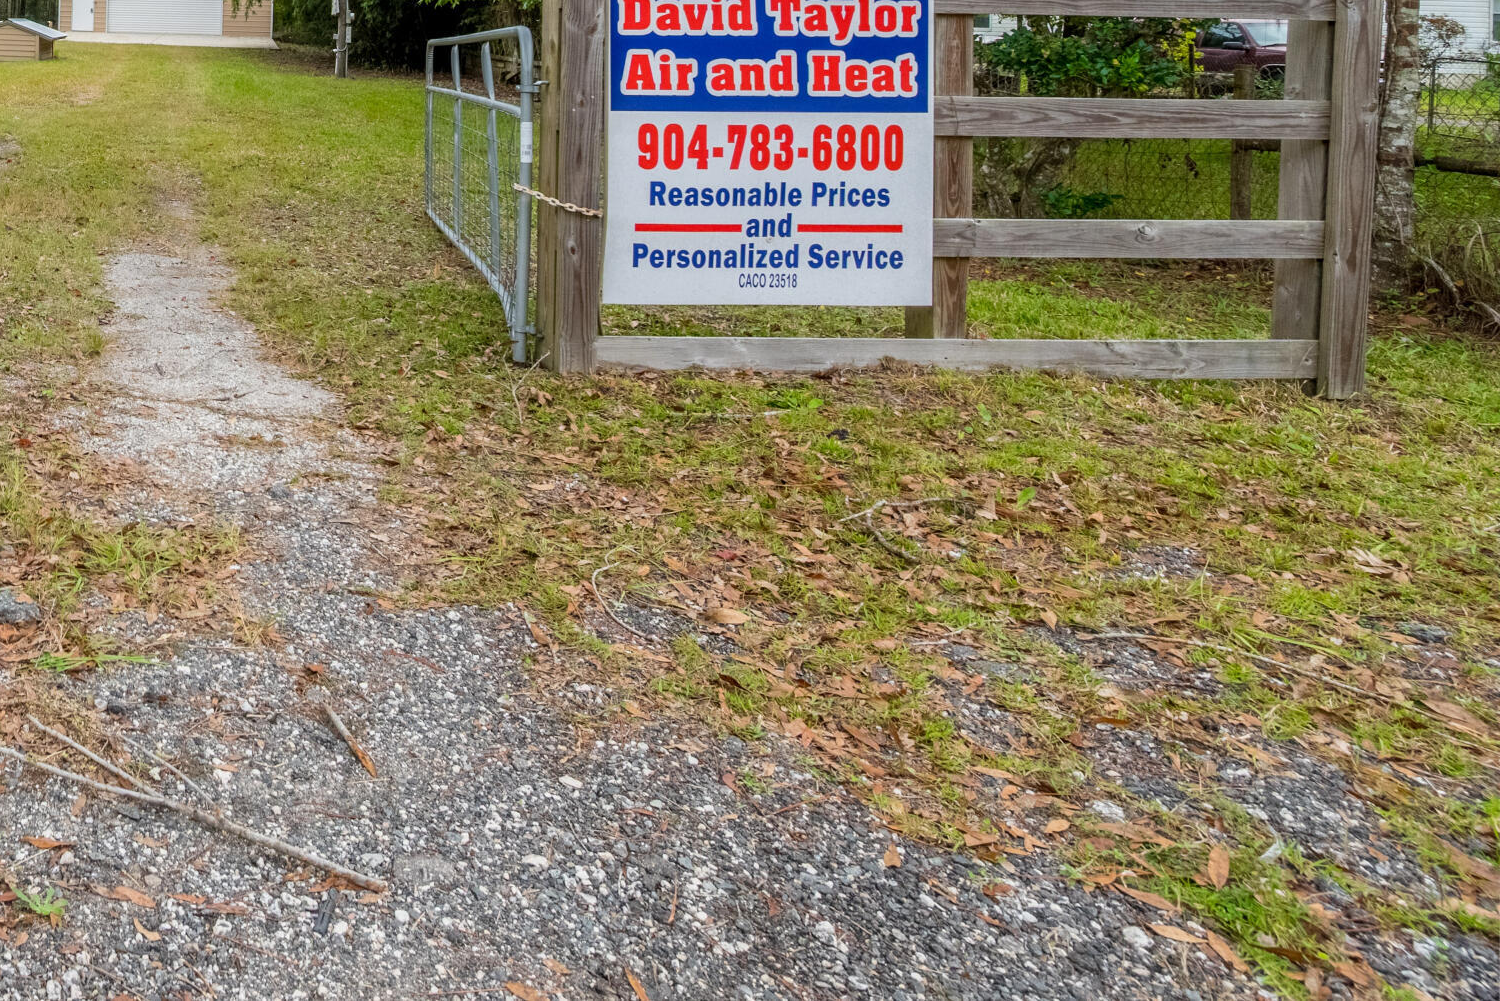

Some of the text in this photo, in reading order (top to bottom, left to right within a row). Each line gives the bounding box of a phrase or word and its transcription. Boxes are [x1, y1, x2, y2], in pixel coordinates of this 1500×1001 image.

[625, 53, 914, 93] Air and Heat
[638, 123, 904, 171] 904-783-6800
[649, 181, 890, 207] Reasonable Prices
[746, 213, 792, 238] and
[632, 243, 904, 270] Personalized Service
[739, 274, 797, 288] CACO 23518
